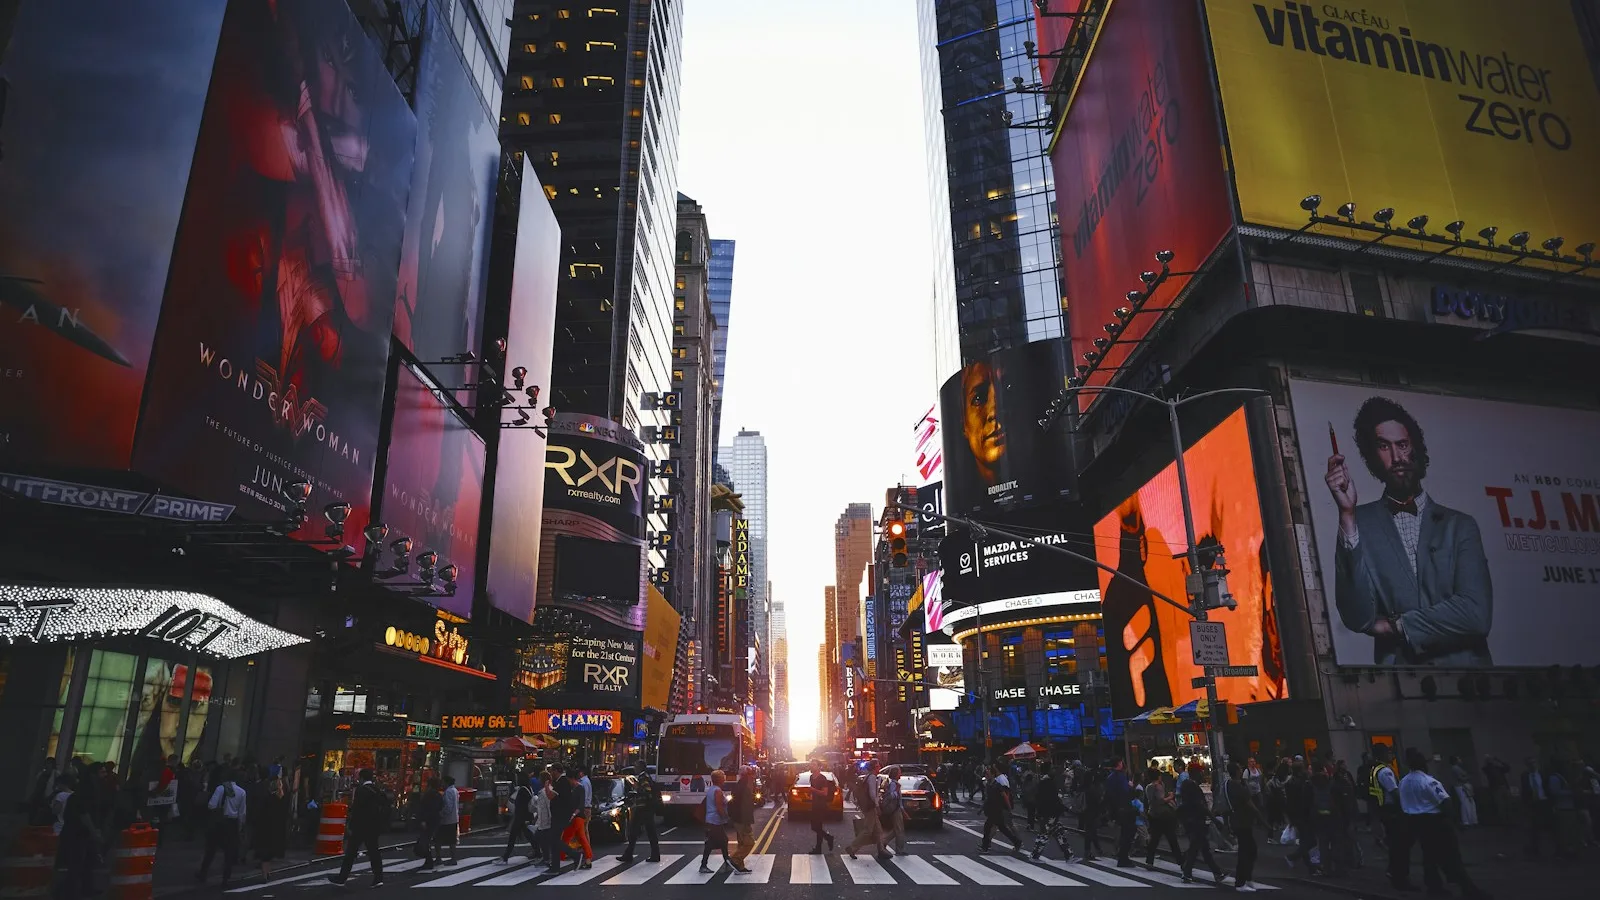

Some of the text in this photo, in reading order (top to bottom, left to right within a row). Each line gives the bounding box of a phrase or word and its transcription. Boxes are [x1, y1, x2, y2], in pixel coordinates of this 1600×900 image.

[1253, 0, 1551, 104] vitaminwater
[1457, 93, 1572, 150] zero
[1133, 97, 1180, 207] zero
[199, 341, 360, 466] WONDER WOMAN
[205, 415, 220, 430] THE
[223, 426, 250, 447] FUTURE
[253, 443, 263, 453] OF
[266, 451, 292, 470] JUSTICE
[252, 465, 288, 494] JUN
[545, 444, 641, 502] RXR
[1514, 474, 1530, 484] AN
[1534, 475, 1562, 486] HBO
[567, 488, 621, 505] rxrrealty.com
[661, 394, 676, 583] CHAMPS
[987, 480, 1019, 495] EQUALITY.
[153, 498, 225, 521] PRIME
[392, 483, 474, 548] WONDER WOMAN
[1485, 486, 1560, 530] T.J.
[542, 518, 580, 526] SHARP
[736, 519, 748, 586] MADAME
[983, 541, 1017, 556] MAZDA
[984, 551, 1029, 568] SERVICES
[1543, 565, 1586, 583] JUNE
[1005, 598, 1033, 608] CHASE
[143, 604, 240, 650] LOFT
[1196, 625, 1219, 633] BUSES
[607, 638, 623, 649] New
[623, 641, 635, 651] York
[1200, 634, 1217, 642] ONLY
[572, 648, 637, 666] for the 21st Century
[912, 631, 922, 668] VICTORY
[583, 663, 629, 686] RXR
[1224, 667, 1257, 676] Broadway
[593, 684, 622, 692] REALTY
[845, 666, 855, 719] REGAL
[994, 688, 1026, 700] CHASE
[1039, 684, 1081, 697] CHASE
[452, 715, 484, 728] KNOW
[548, 713, 613, 730] CHAMPS
[1179, 733, 1200, 745] SODA
